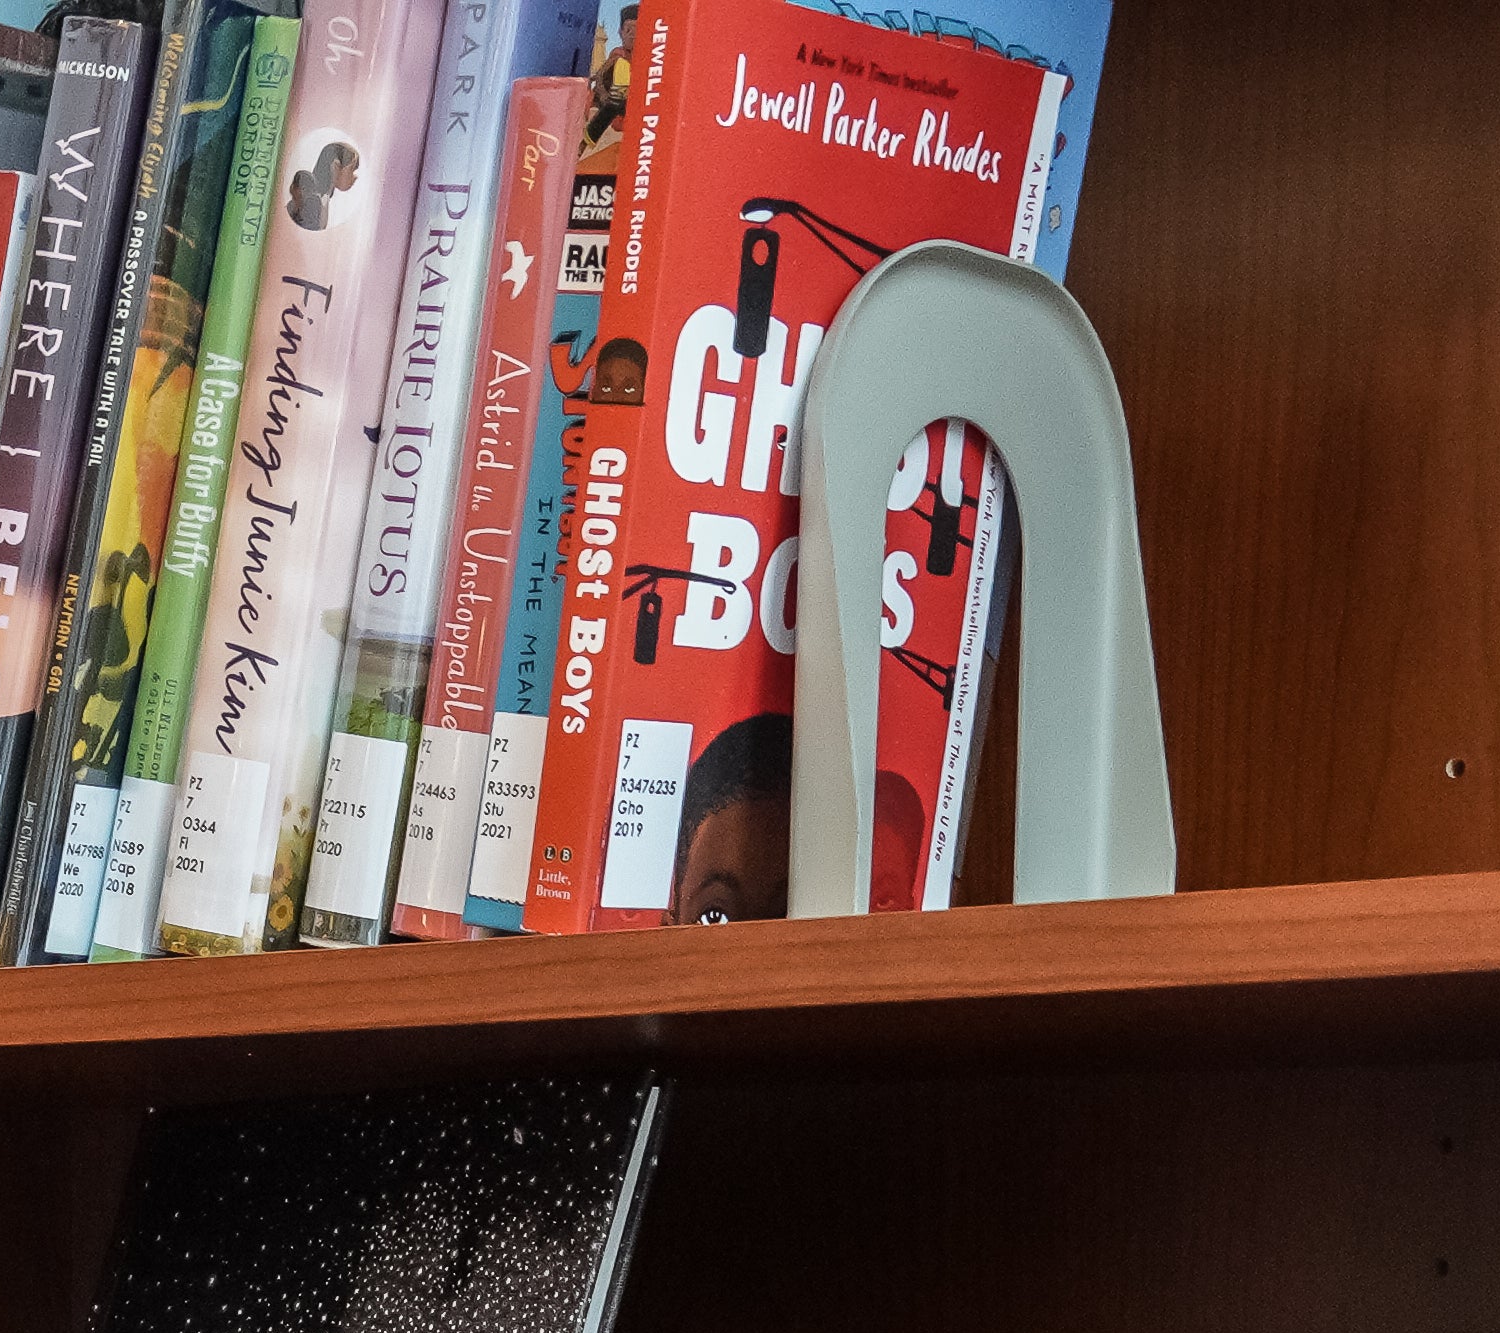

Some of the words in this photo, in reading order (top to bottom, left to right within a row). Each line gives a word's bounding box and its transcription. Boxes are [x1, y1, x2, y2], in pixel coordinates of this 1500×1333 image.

[645, 19, 667, 105] JEWELL
[233, 97, 264, 197] GORDON
[634, 115, 657, 203] PARKER
[716, 54, 813, 134] Jewell
[823, 82, 903, 160] Parker
[913, 108, 1002, 183] Rhodes
[10, 126, 102, 401] WHERE
[622, 210, 645, 294] RHODES
[396, 183, 471, 411] PRAIRIE
[239, 275, 334, 488] Finding
[475, 349, 532, 472] Astrid
[367, 422, 433, 600] LOTUS
[237, 487, 298, 636] Junie
[526, 552, 546, 612] THE
[54, 574, 80, 649] NEWMAN
[441, 526, 513, 732] Unstoppable
[962, 576, 983, 657] bestselling
[46, 663, 64, 695] GAL
[215, 640, 279, 755] Kim
[561, 615, 608, 736] BOYS
[953, 662, 973, 713] author
[618, 801, 643, 816] Gho
[621, 778, 677, 796] R3476235
[176, 857, 205, 873] 2021
[481, 823, 512, 839] 2021
[614, 822, 643, 838] 2019
[934, 830, 948, 863] Give
[107, 880, 135, 896] 2018
[536, 883, 570, 900] Brown
